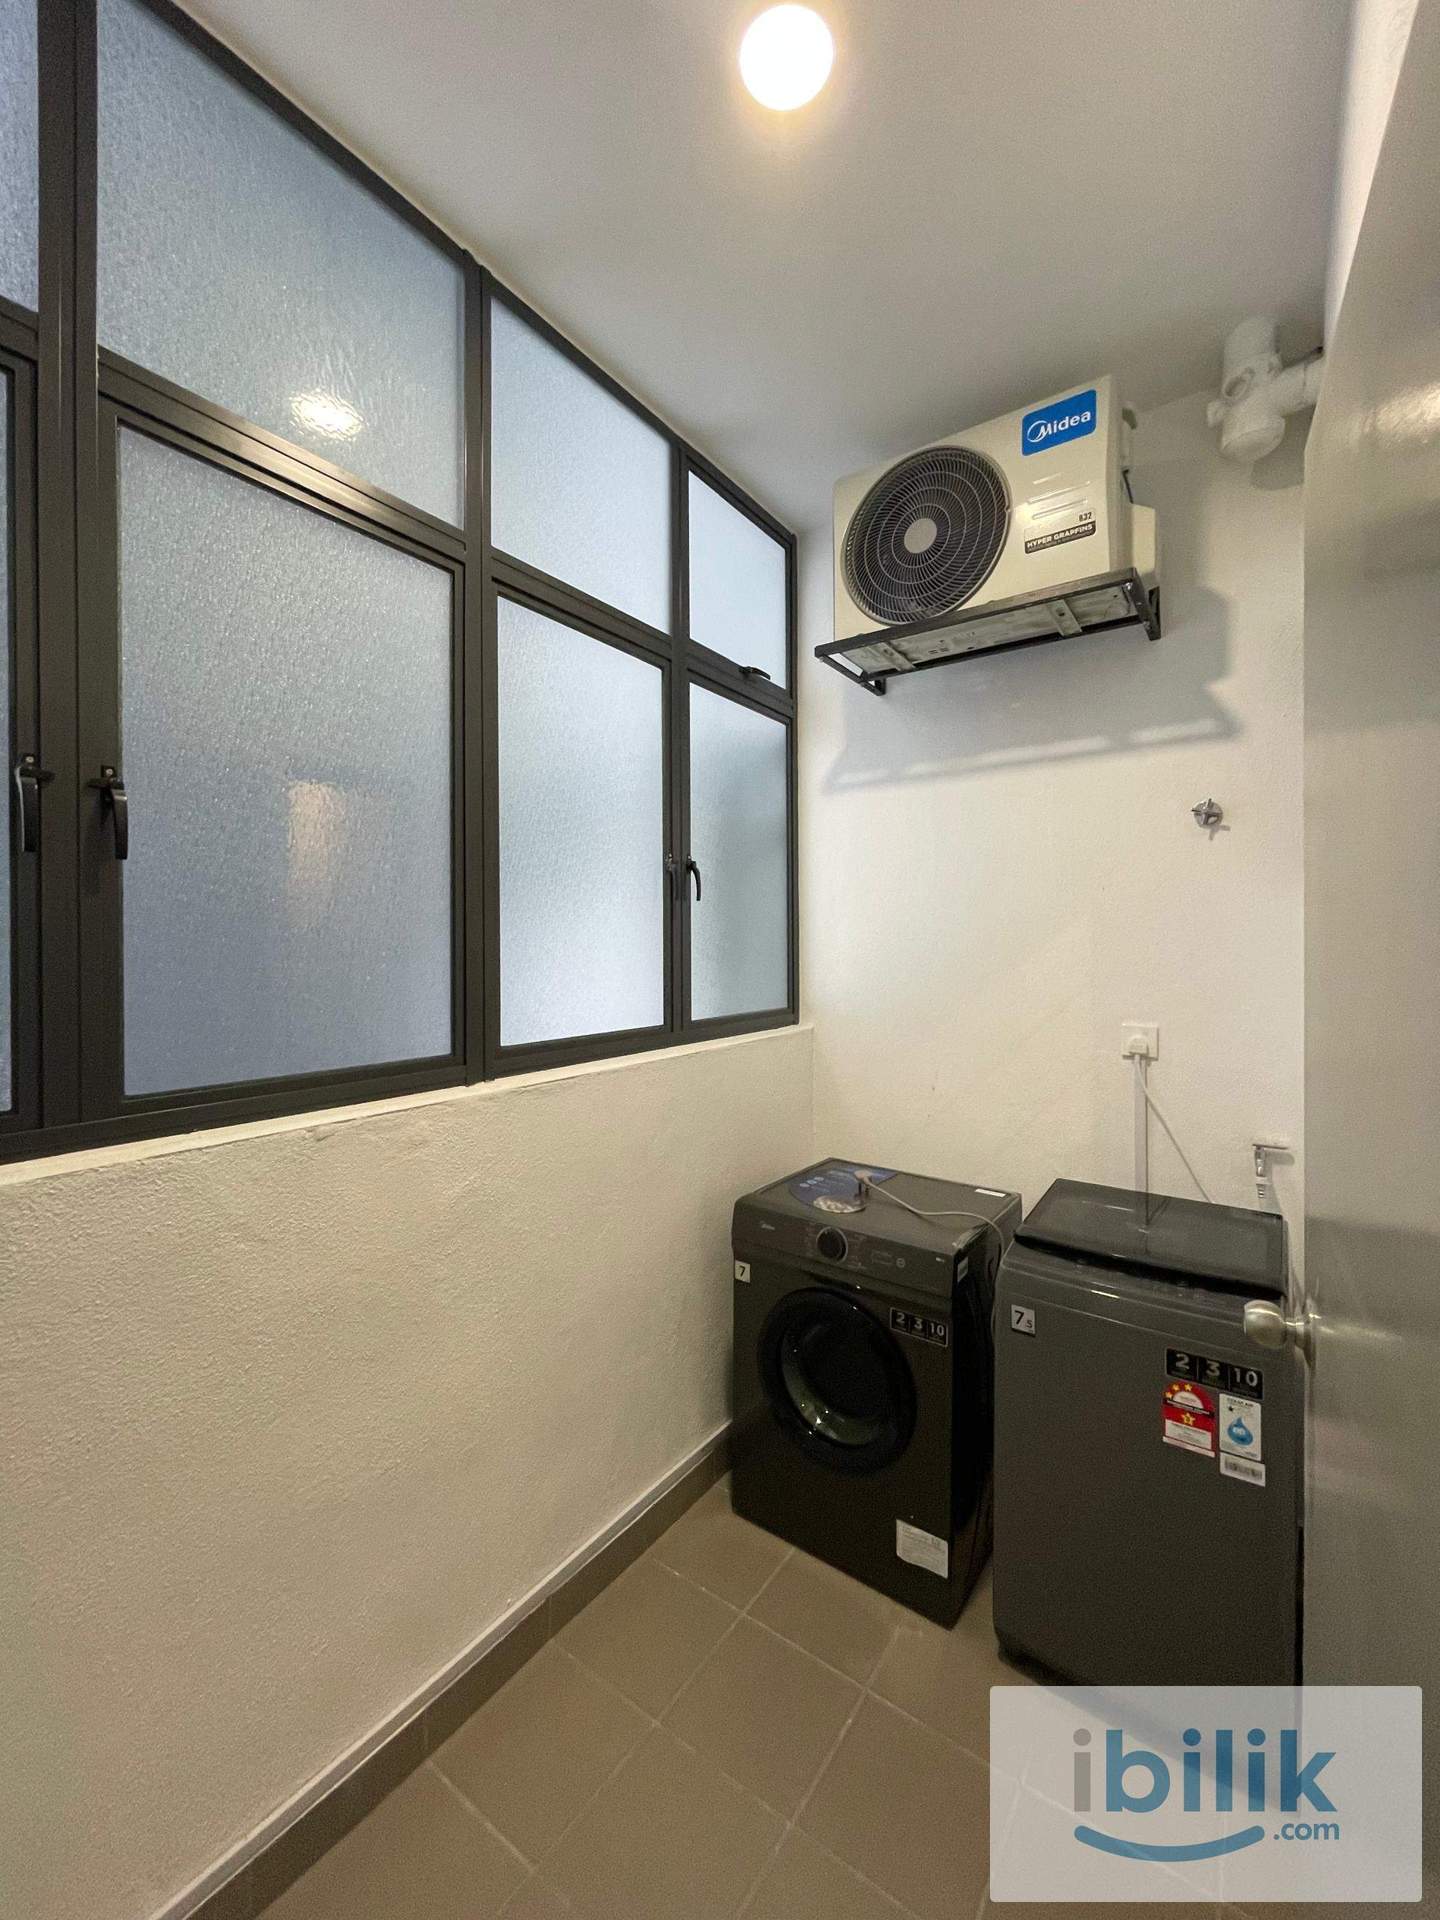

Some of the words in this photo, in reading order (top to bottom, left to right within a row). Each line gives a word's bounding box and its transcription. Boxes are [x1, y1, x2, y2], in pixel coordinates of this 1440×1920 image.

[1027, 410, 1092, 442] Midea
[1027, 536, 1052, 548] HYPER
[1054, 524, 1093, 540] GRAPFINS
[739, 1265, 746, 1277] 7
[895, 1312, 905, 1323] 2
[914, 1318, 923, 1330] 3
[930, 1323, 945, 1337] 10
[1175, 1353, 1190, 1370] 2
[1206, 1361, 1221, 1376] 3
[1234, 1368, 1258, 1386] 10
